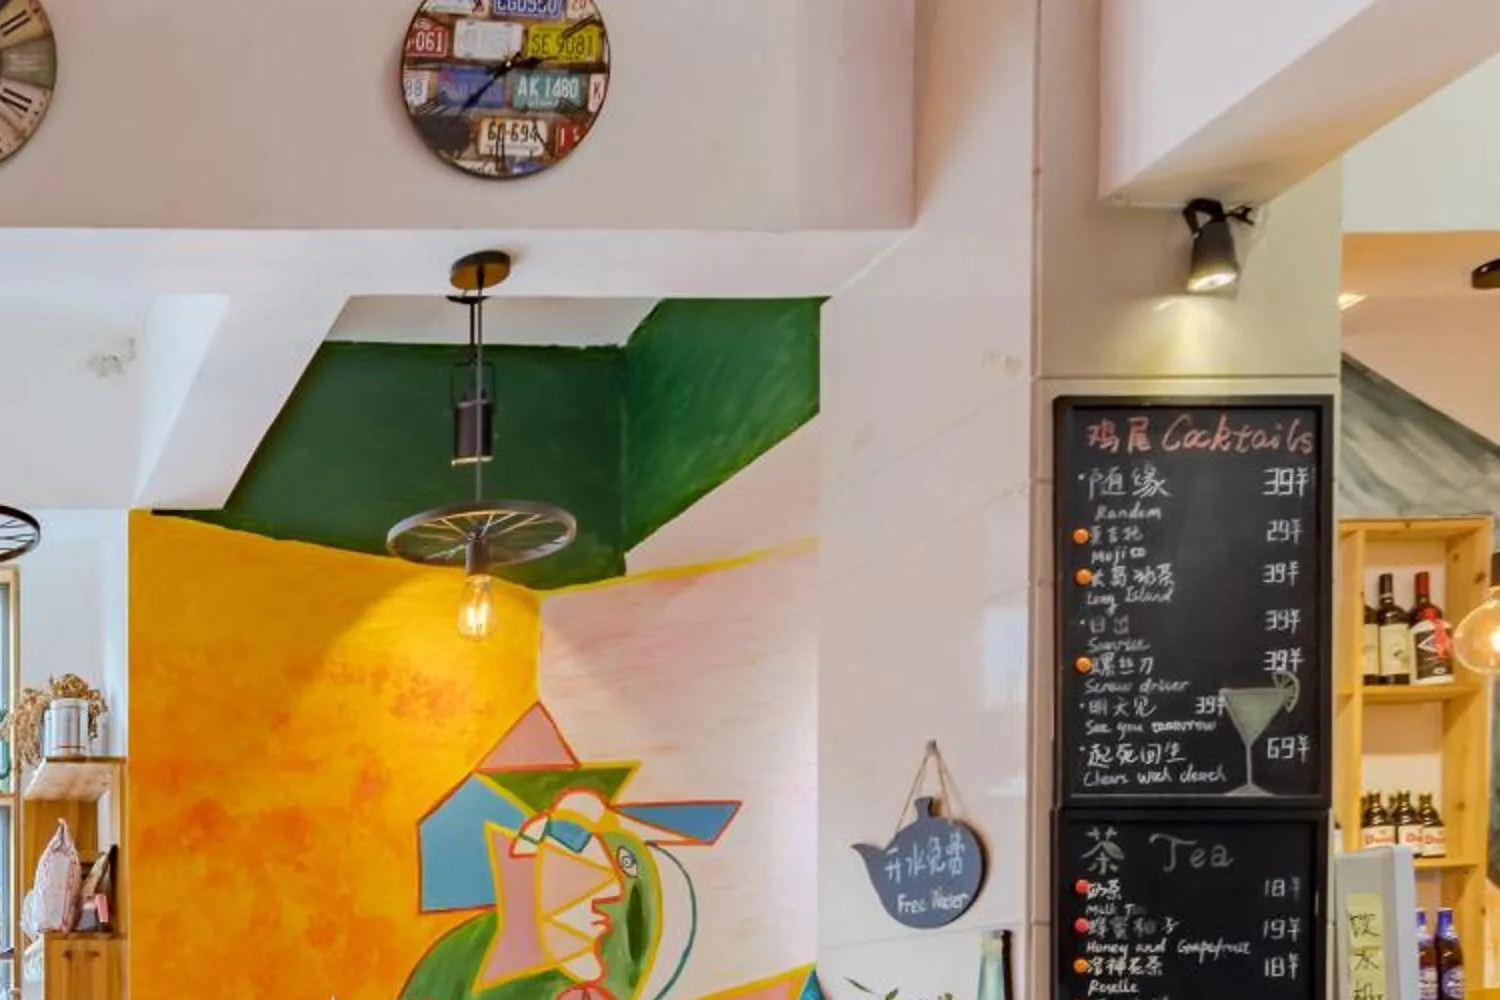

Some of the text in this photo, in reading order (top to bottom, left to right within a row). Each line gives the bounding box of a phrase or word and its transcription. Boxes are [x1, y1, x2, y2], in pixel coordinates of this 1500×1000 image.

[1161, 413, 1315, 455] Cocktails
[1081, 826, 1235, 876] 茶 Tea
